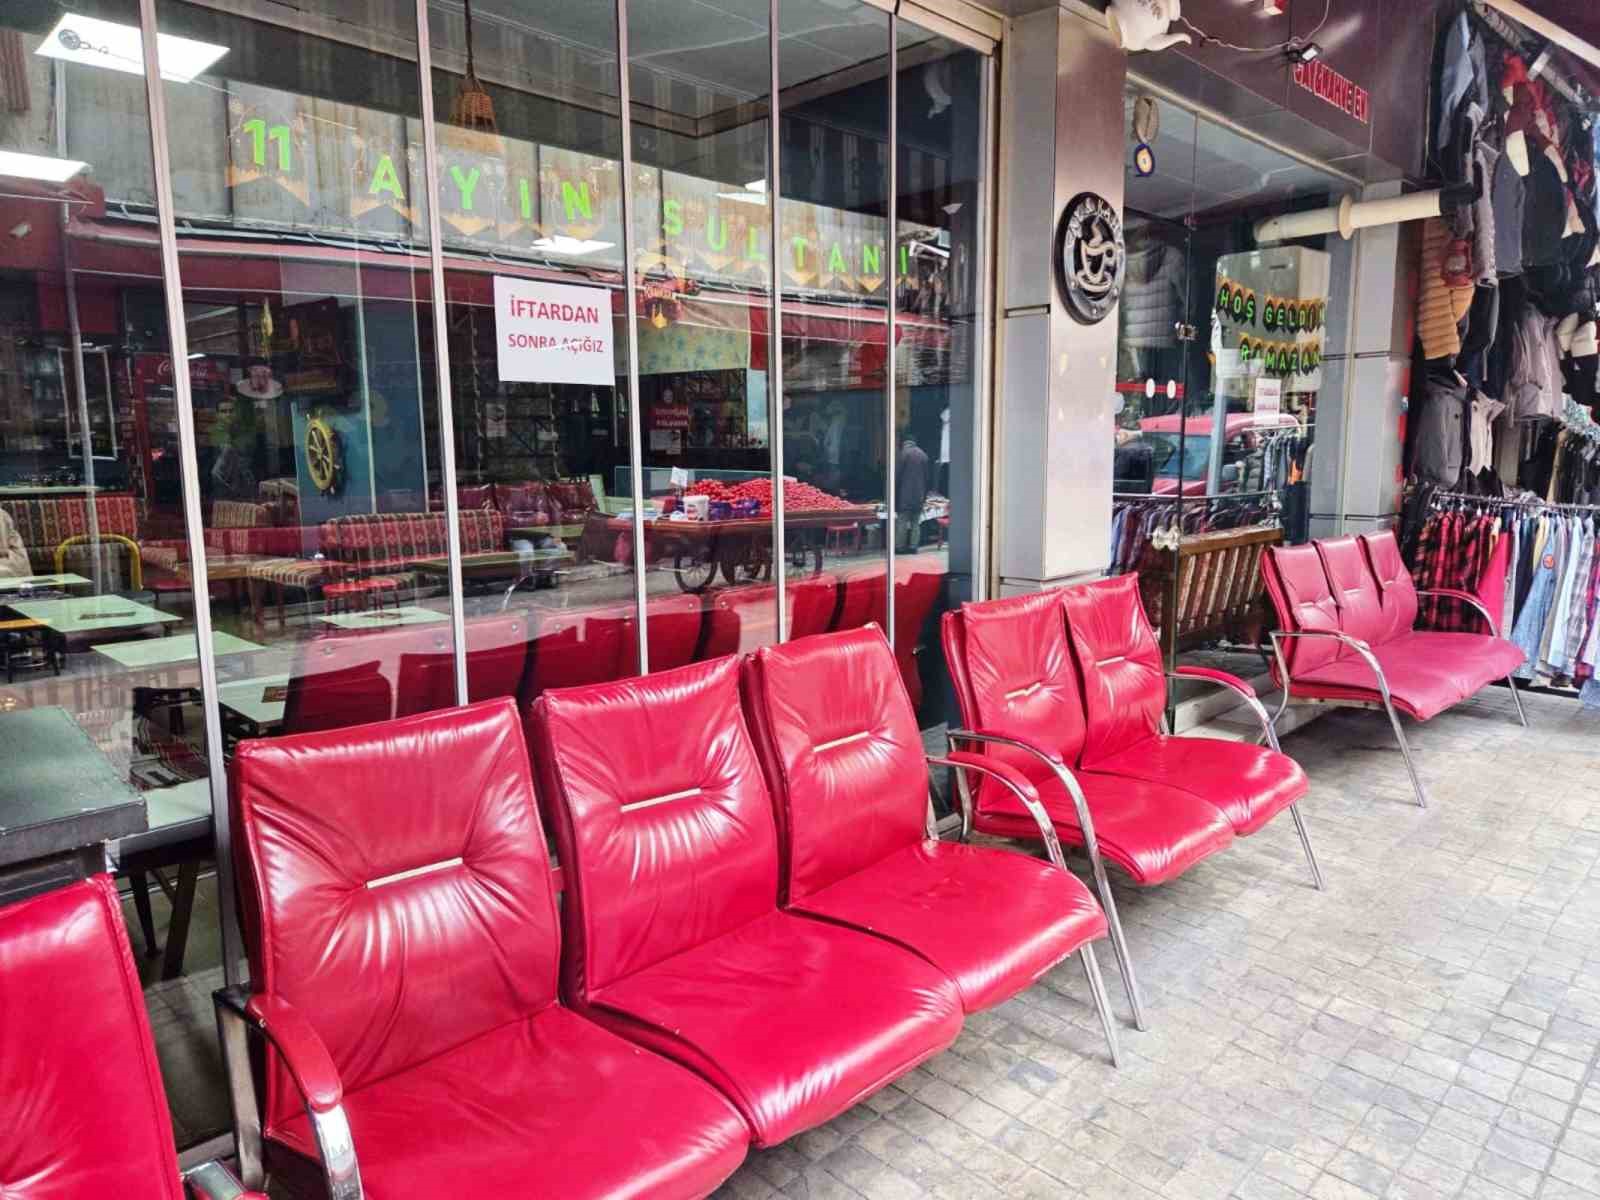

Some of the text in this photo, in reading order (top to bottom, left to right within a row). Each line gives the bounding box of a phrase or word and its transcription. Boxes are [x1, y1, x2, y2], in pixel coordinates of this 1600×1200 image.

[243, 119, 909, 275] 11 AYIN SULTANI
[509, 294, 599, 323] İFTARDAN
[507, 333, 557, 349] SONRA
